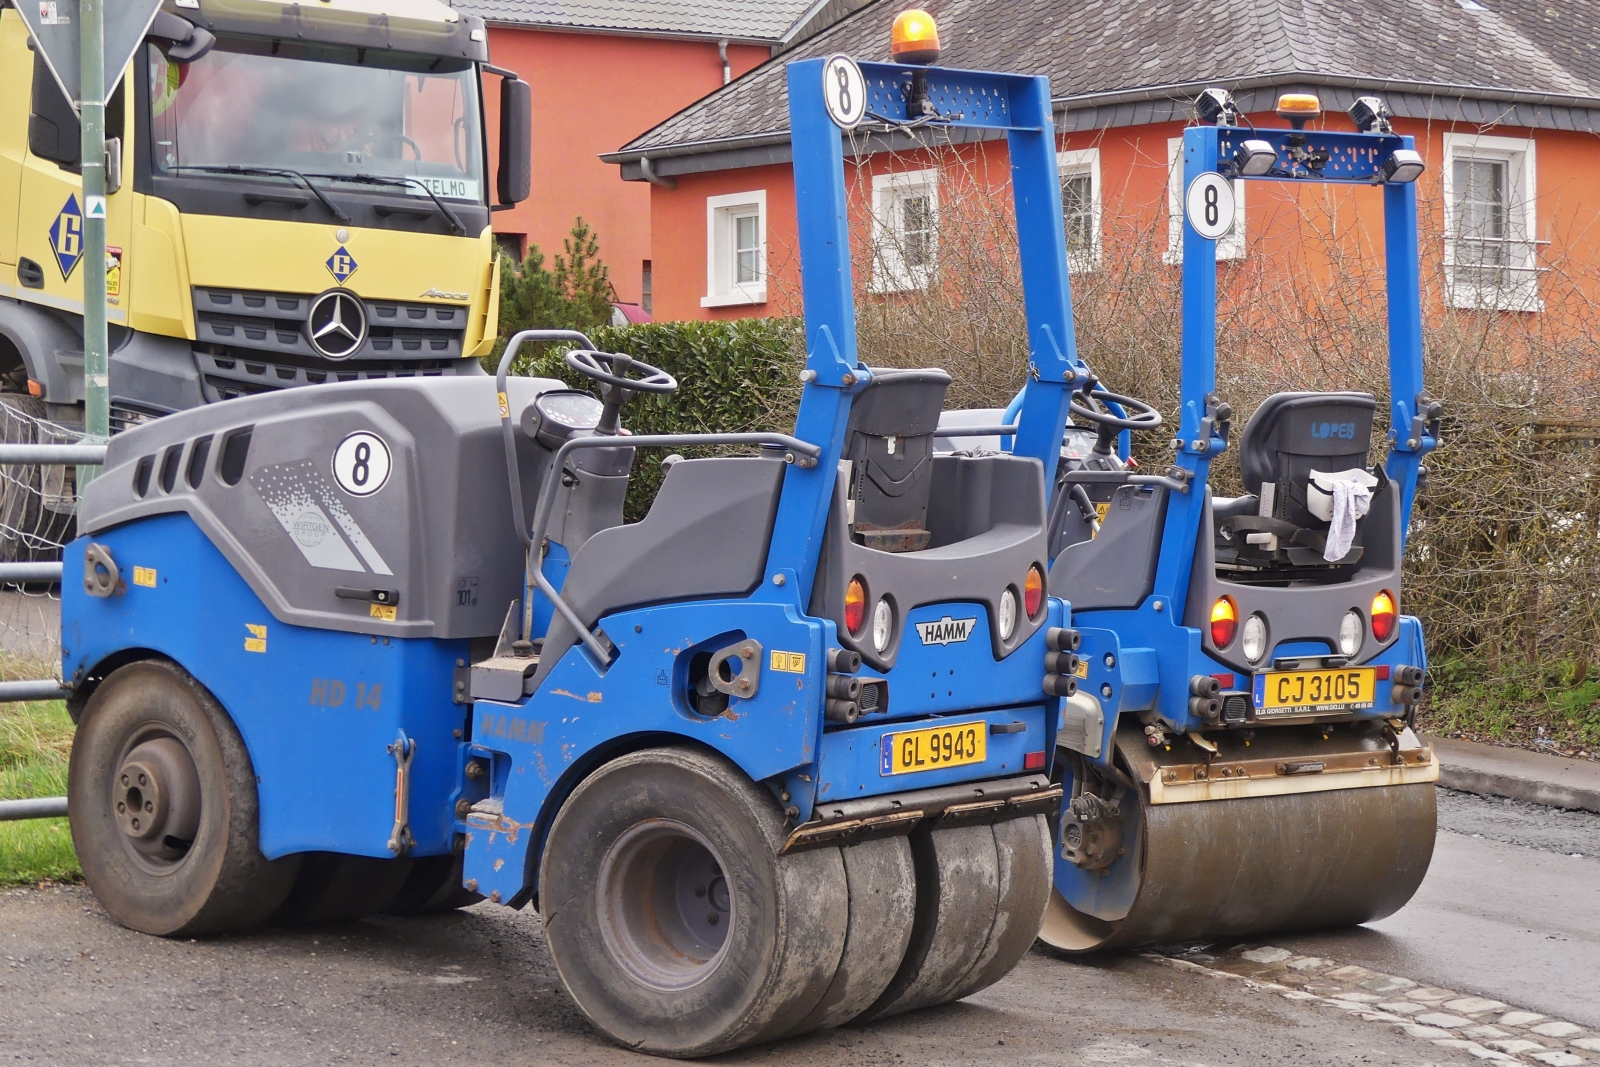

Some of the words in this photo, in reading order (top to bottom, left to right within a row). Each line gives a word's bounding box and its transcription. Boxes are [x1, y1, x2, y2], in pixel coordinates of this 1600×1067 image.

[837, 66, 852, 116] 8
[423, 179, 466, 196] TELMO
[1204, 184, 1219, 227] 8
[57, 212, 81, 257] G
[333, 254, 351, 275] G
[1311, 422, 1355, 439] LOPES
[352, 442, 371, 487] 8
[293, 520, 330, 532] WIRTGEN
[294, 529, 326, 538] GROUP
[457, 589, 471, 606] 101
[925, 622, 966, 642] HAMM
[309, 677, 346, 708] HD
[356, 681, 383, 712] 14
[1255, 693, 1260, 703] L
[1277, 676, 1305, 703] CJ
[1309, 672, 1361, 702] 3105
[1255, 708, 1266, 716] ELIX
[481, 713, 544, 744] HAMM
[884, 758, 889, 769] L
[902, 736, 925, 767] GL
[930, 728, 976, 764] 9943
